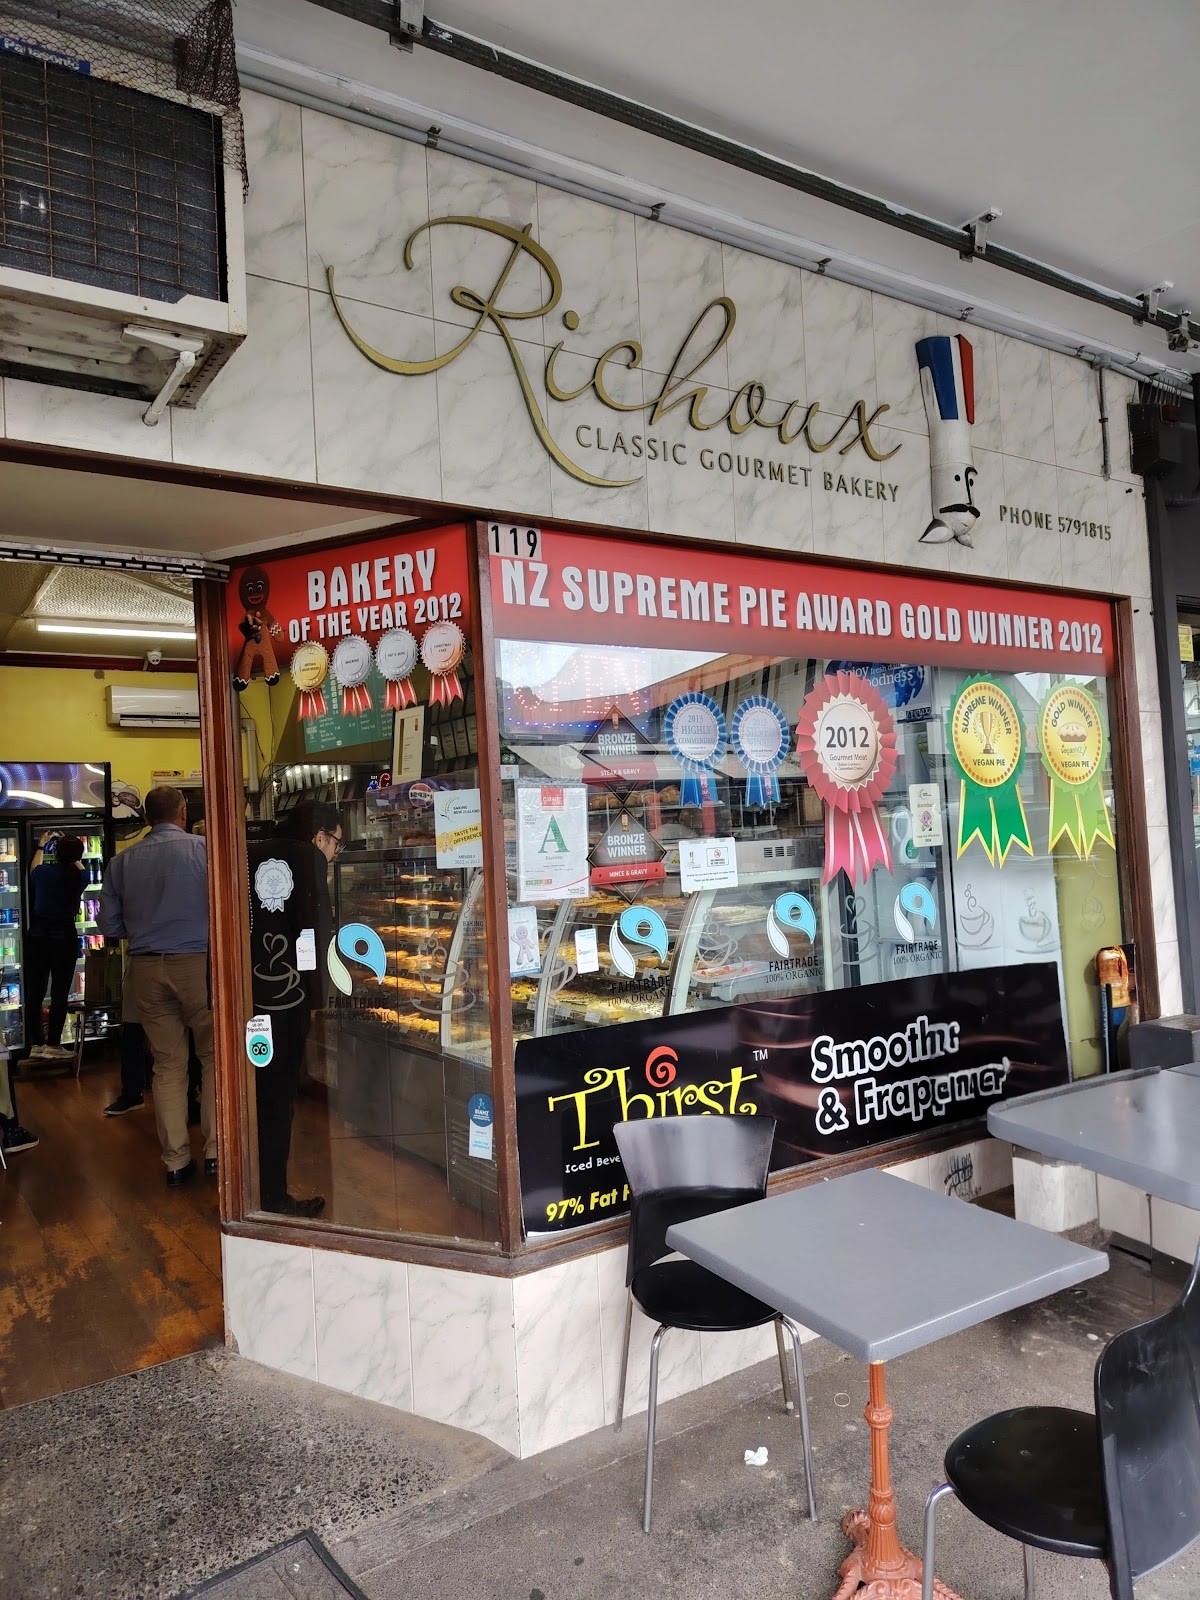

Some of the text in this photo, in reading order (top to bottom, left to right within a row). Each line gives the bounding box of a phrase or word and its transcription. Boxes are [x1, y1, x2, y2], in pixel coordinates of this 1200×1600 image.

[327, 215, 902, 488] Richoux
[576, 424, 900, 502] CLASSIC GOURMET BAKERY
[999, 504, 1112, 541] PHONE 5791815
[490, 525, 538, 558] 119
[307, 548, 436, 611] BAKERY
[501, 559, 1104, 654] NZ SUPREME PIE AWARD GOLD WINNER 2012
[288, 592, 462, 644] OF THE YEAR 2012
[962, 695, 1012, 735] SUPREME WINNER
[1051, 699, 1093, 728] GOLD WINNER
[597, 732, 637, 745] BRONZE
[681, 726, 712, 735] HIGHLY
[825, 726, 870, 748] 2012
[598, 744, 638, 756] WINNER
[829, 753, 868, 761] Gourmet Meat
[973, 759, 1006, 767] VEGAN PIE
[1060, 760, 1081, 768] VEGAN
[454, 829, 469, 837] TASTE
[538, 814, 571, 853] A
[607, 833, 645, 846] BRONZE
[607, 845, 647, 858] WINNER
[609, 870, 625, 878] MINCE
[895, 940, 939, 954] FAIRTRADE
[768, 955, 819, 972] FAIRTRADE
[893, 951, 943, 965] 100% ORGANIC
[765, 966, 824, 984] 100% ORGANIC
[611, 975, 671, 994] FAIRTRADE
[631, 988, 677, 1003] ORGANIC
[548, 1045, 768, 1151] Thirst TM
[816, 1087, 849, 1135] &
[564, 1156, 593, 1174] Iced
[546, 1196, 585, 1222] 97%
[589, 1190, 618, 1211] Fat
